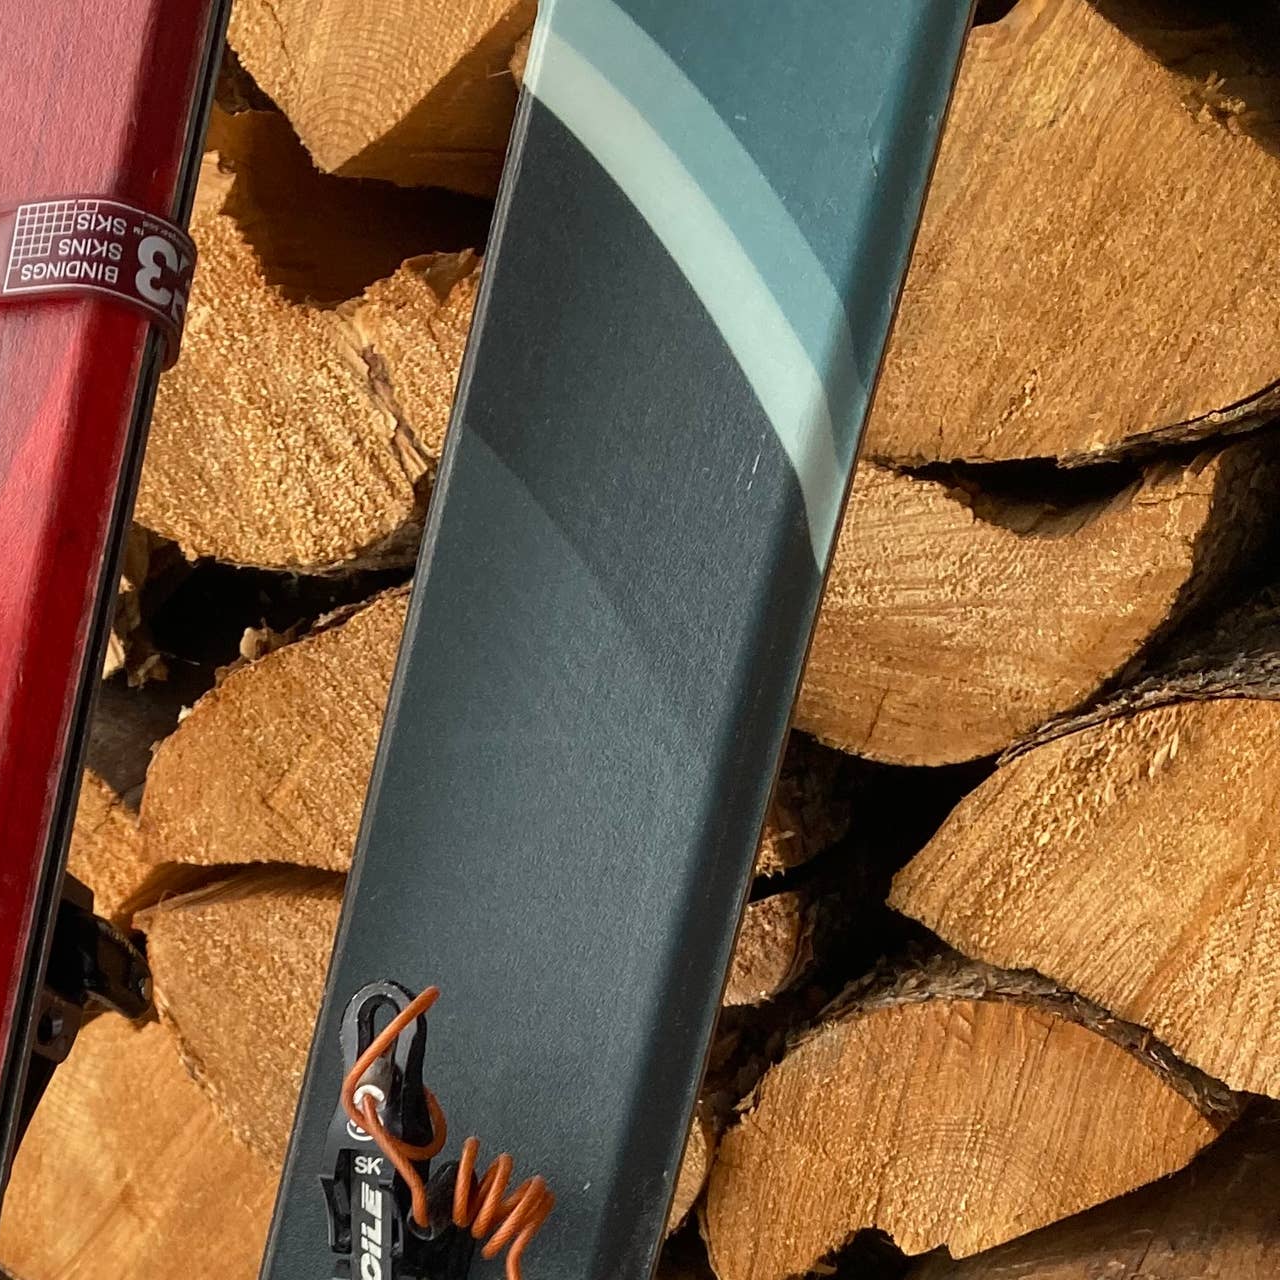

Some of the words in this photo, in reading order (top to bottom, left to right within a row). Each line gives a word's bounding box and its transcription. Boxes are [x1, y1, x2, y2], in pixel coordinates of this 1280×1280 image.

[77, 211, 128, 236] SKIS
[58, 238, 123, 260] SKINS
[21, 262, 119, 284] BINDINGS
